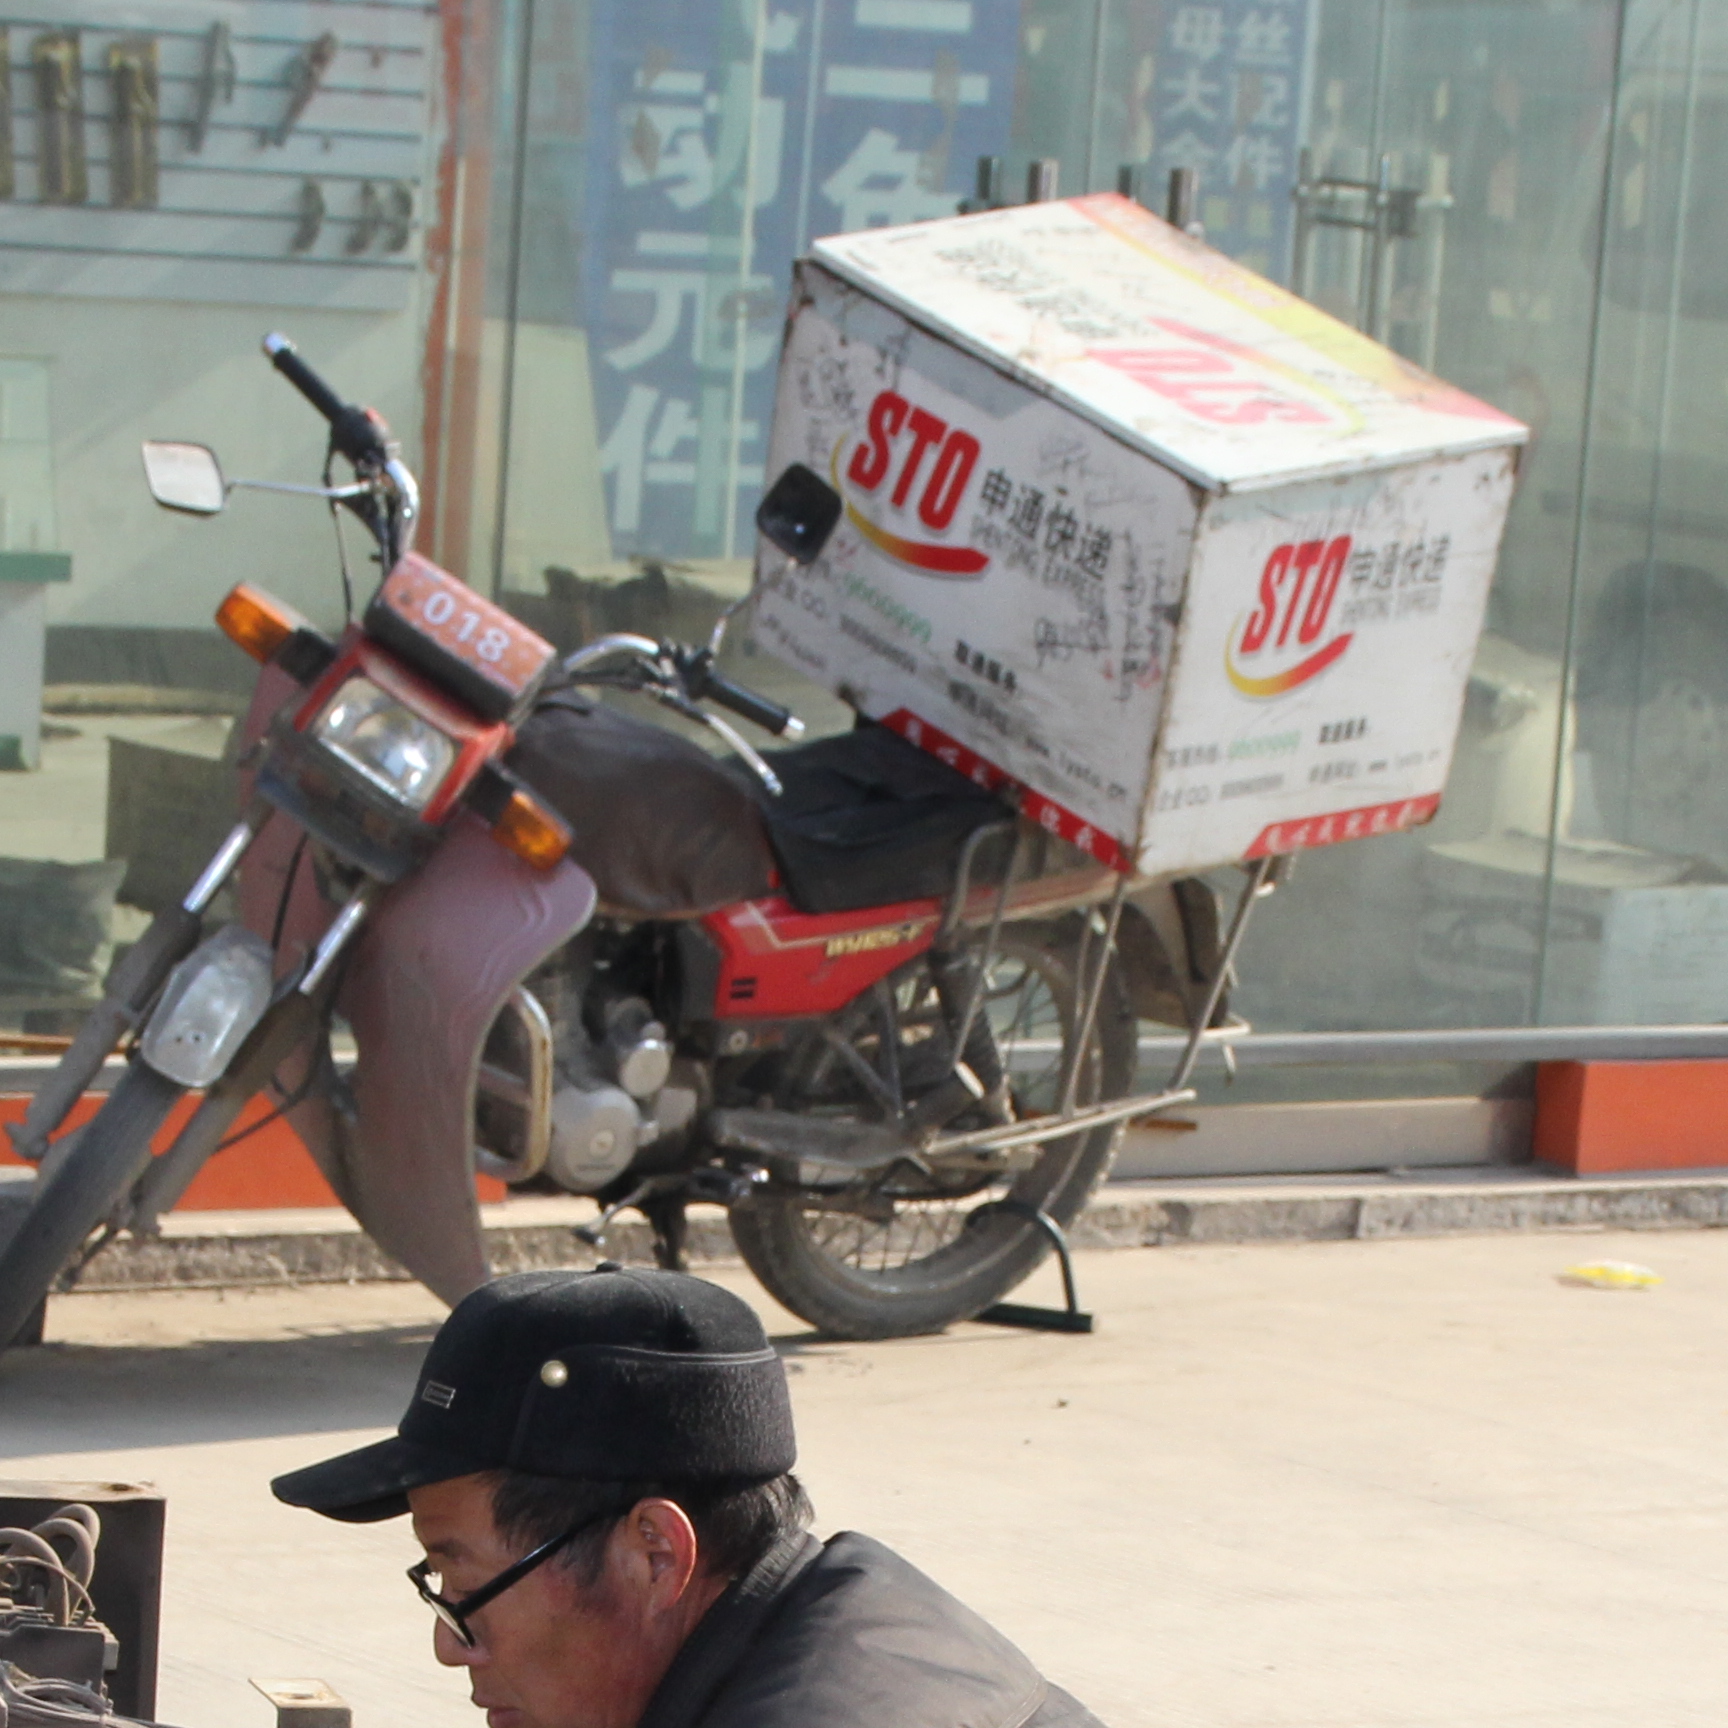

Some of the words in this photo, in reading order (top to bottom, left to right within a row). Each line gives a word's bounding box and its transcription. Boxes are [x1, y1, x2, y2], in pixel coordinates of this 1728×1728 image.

[846, 388, 981, 531] STO
[980, 466, 1113, 581] 申通快递
[423, 592, 511, 663] 018
[1239, 533, 1352, 655] STO
